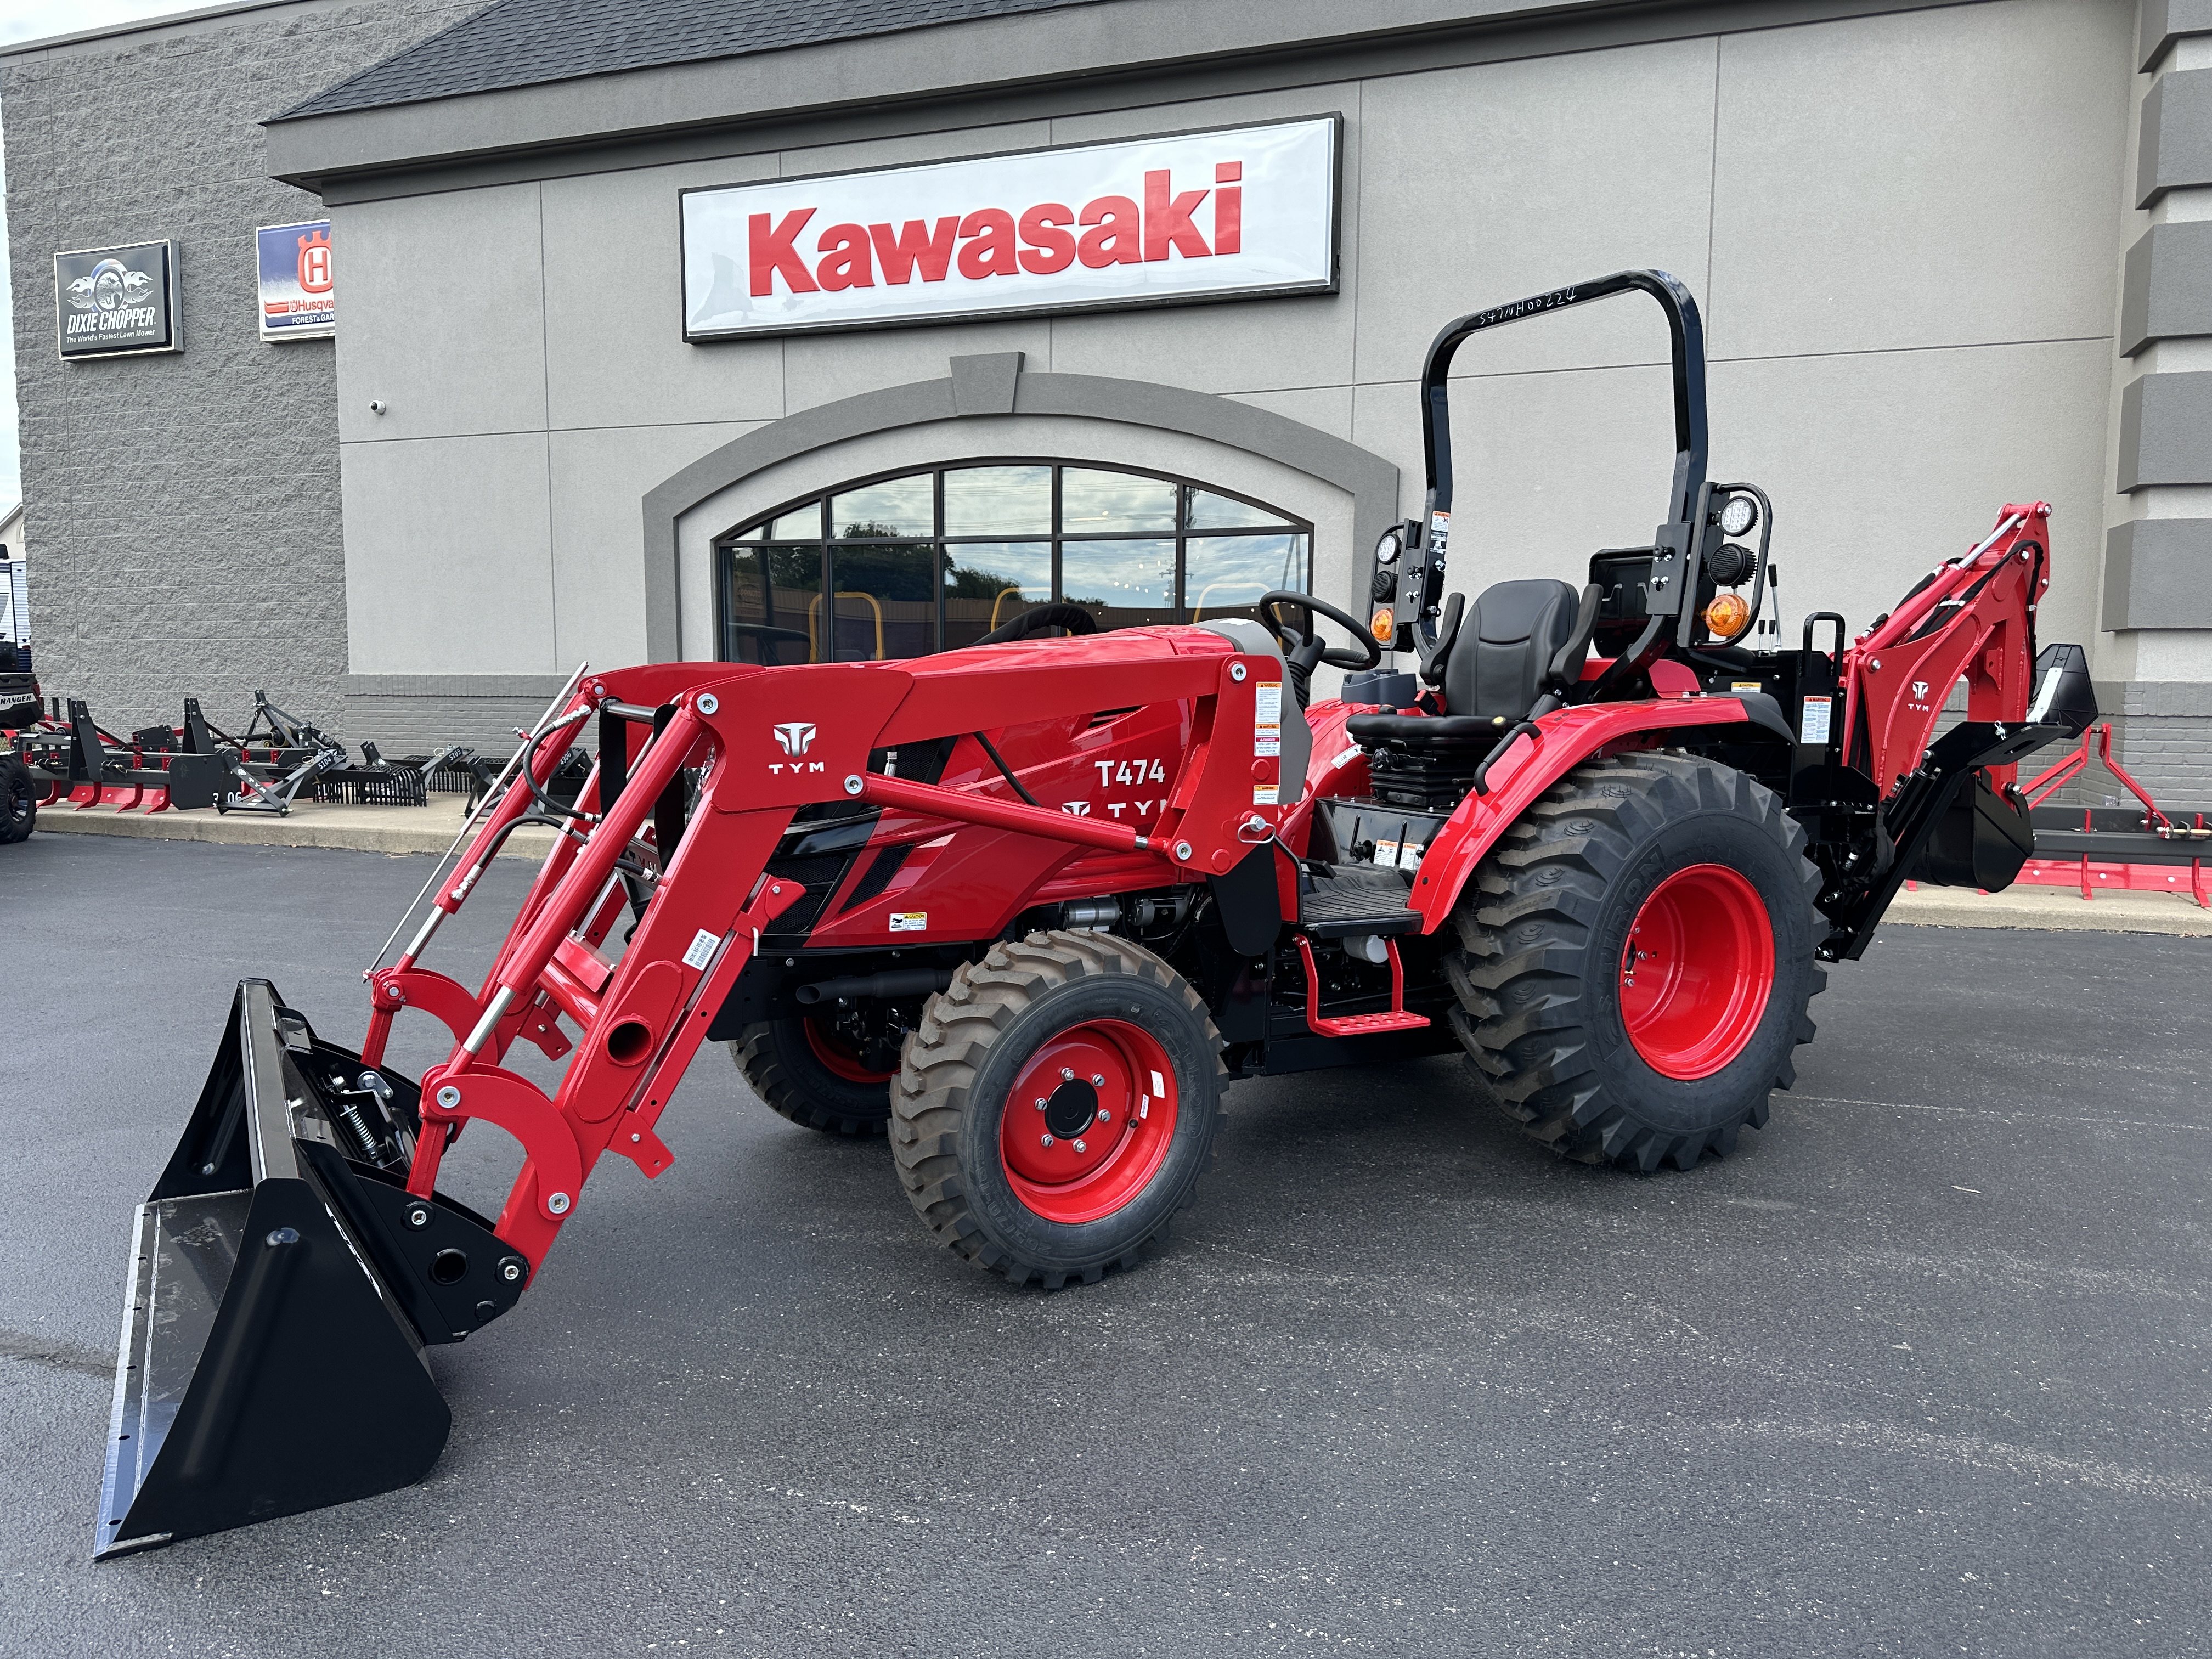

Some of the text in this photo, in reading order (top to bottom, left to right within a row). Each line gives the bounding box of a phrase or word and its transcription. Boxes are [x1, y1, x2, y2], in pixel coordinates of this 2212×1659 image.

[748, 160, 1242, 297] Kawasaki
[308, 250, 328, 283] H
[298, 299, 334, 312] Husqva
[66, 306, 155, 334] DIXIE CHOPPER
[292, 314, 317, 325] FOREST
[77, 334, 98, 342] World's
[99, 331, 119, 340] Fastest
[0, 695, 31, 705] RANGER
[1908, 703, 1929, 712] TYM
[449, 748, 461, 761] 5105
[560, 751, 572, 765] 4306
[318, 756, 332, 770] 5104
[769, 761, 825, 775] TYM
[1094, 758, 1165, 787] T474
[212, 791, 242, 808] 306
